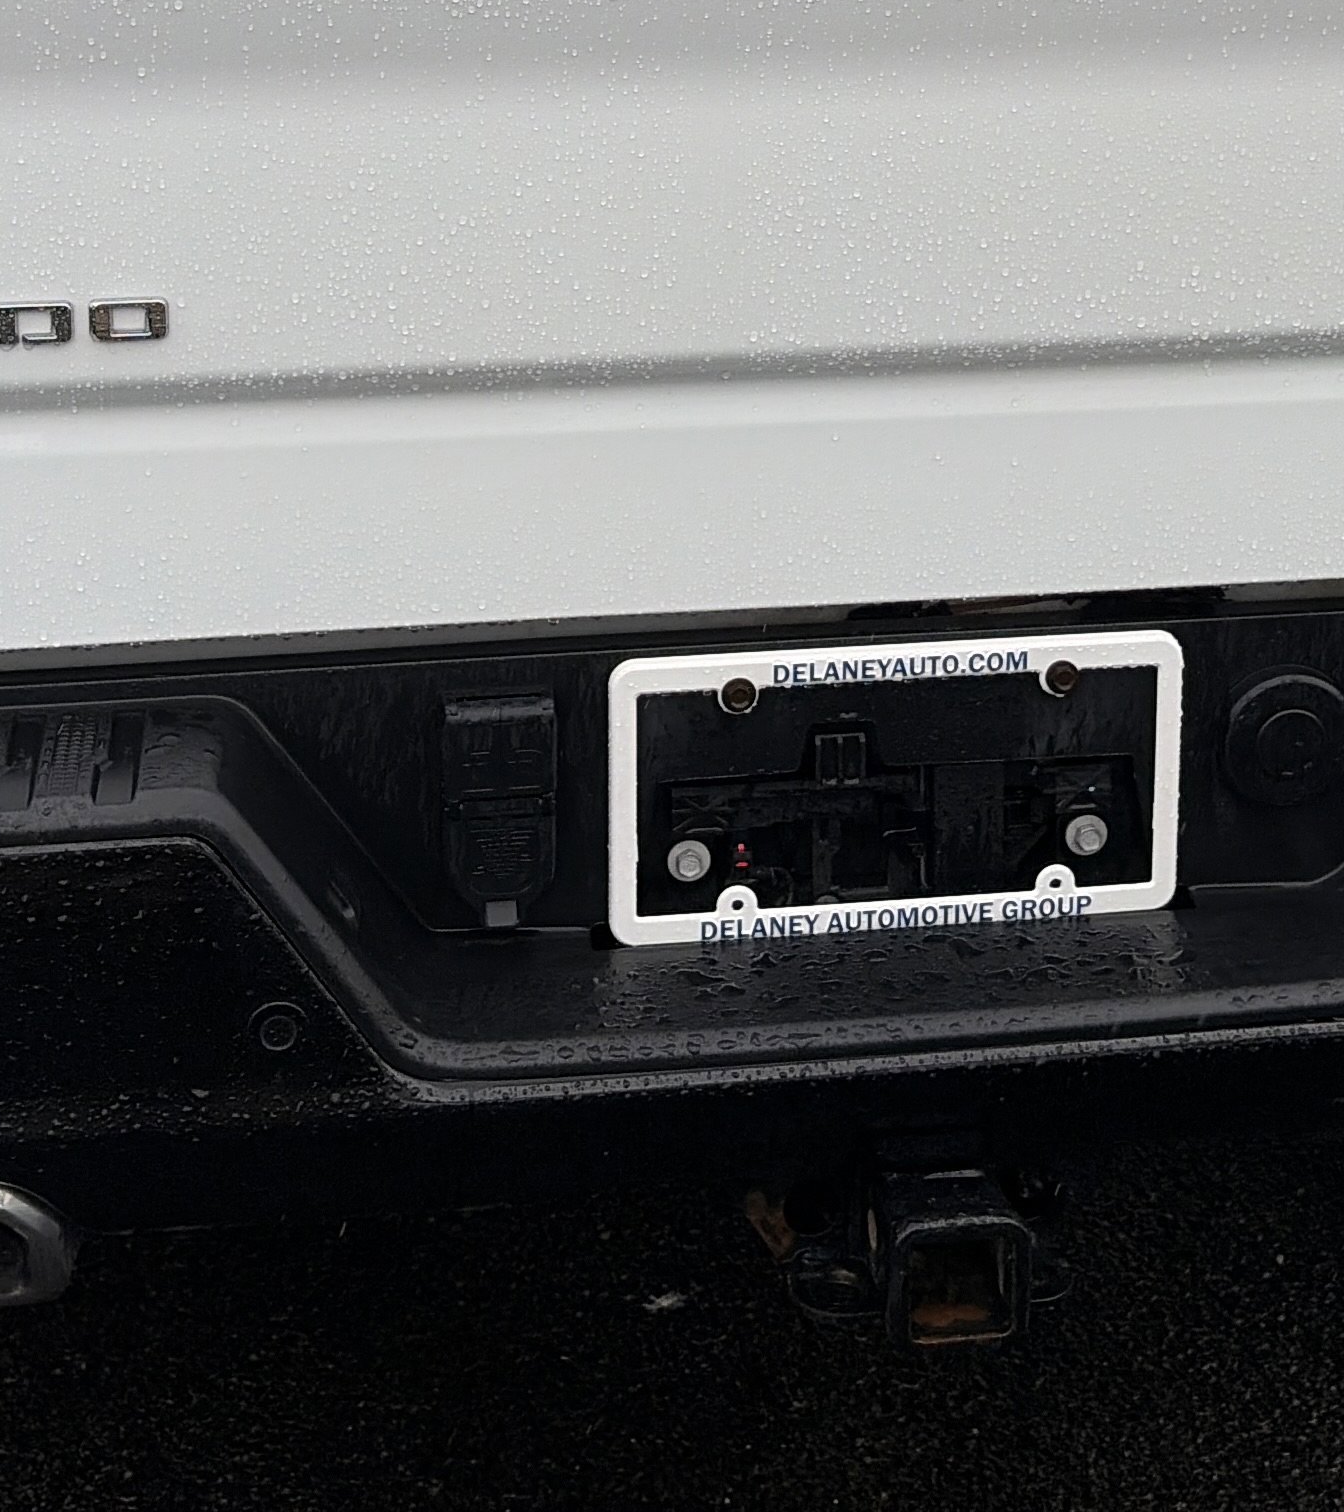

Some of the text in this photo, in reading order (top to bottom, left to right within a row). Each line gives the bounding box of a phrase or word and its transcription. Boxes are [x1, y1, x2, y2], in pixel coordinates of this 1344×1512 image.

[773, 651, 1028, 683] DELANEYAUTO.COM
[701, 895, 1092, 941] DELANEY AUTOMOTIVE GROUP
